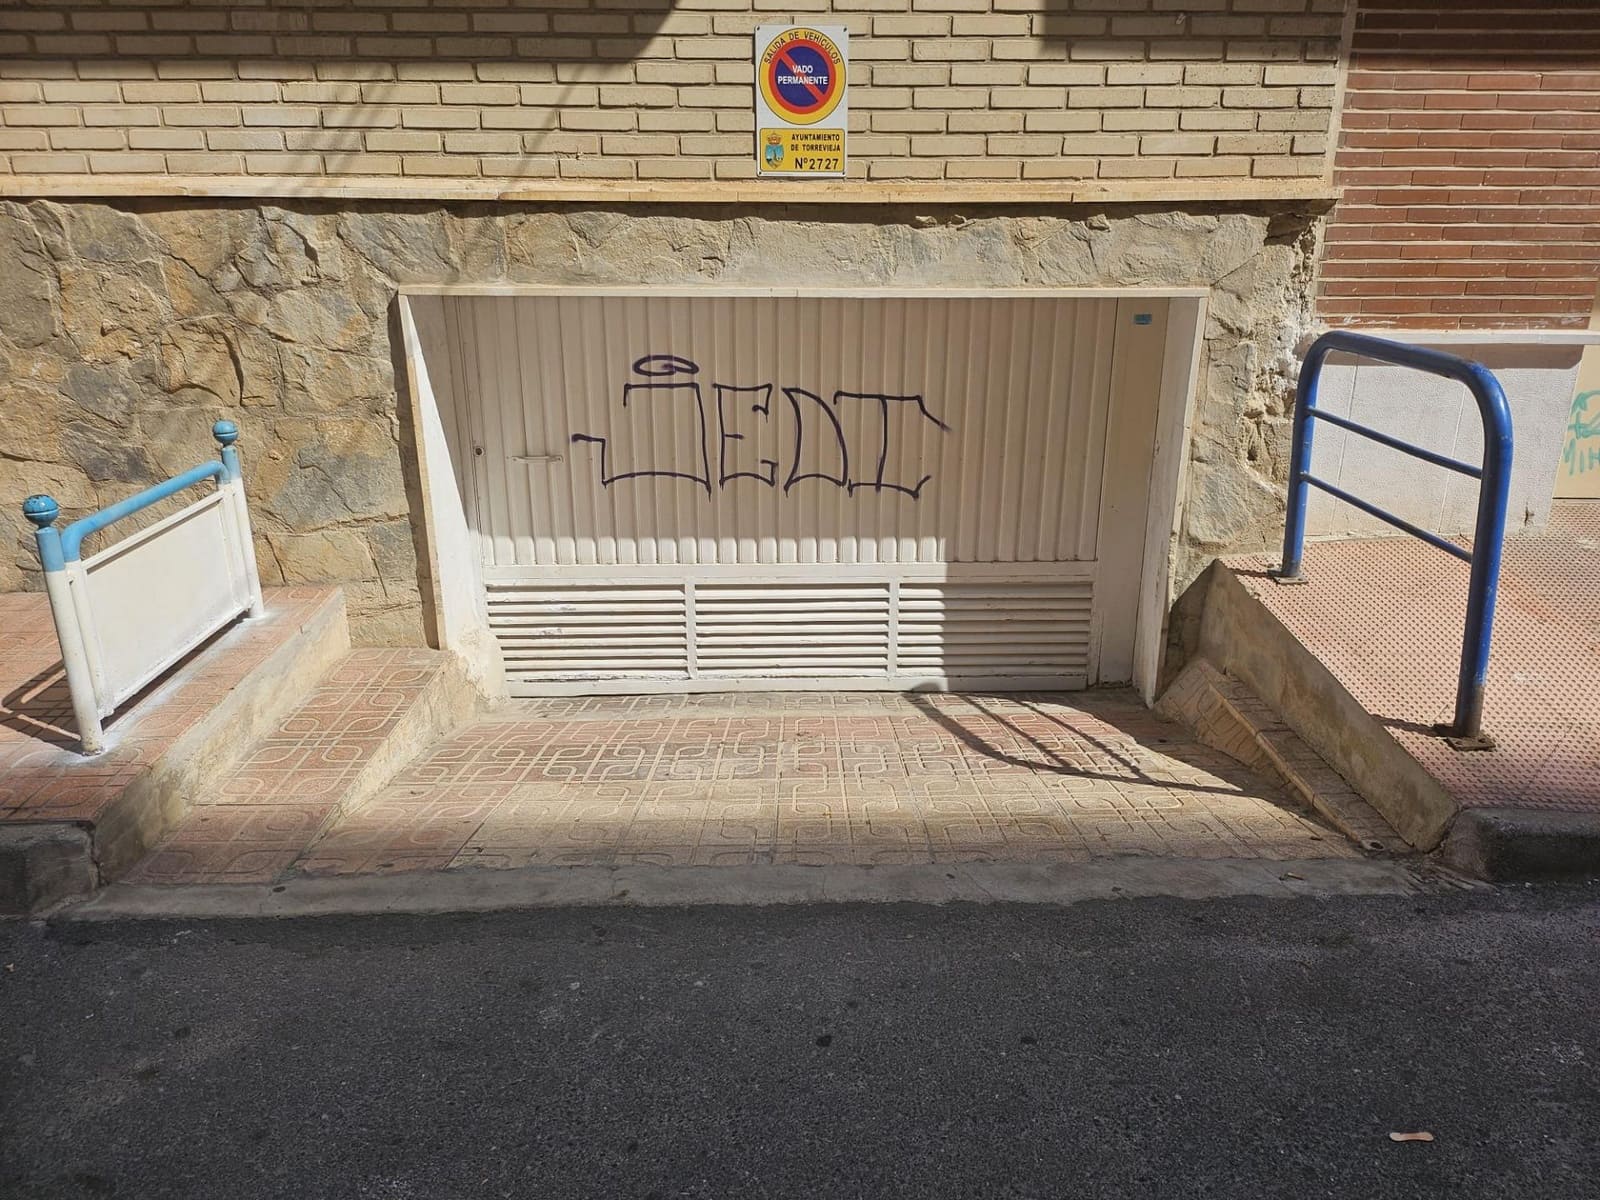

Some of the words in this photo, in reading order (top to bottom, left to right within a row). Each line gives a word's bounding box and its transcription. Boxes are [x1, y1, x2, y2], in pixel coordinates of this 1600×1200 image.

[764, 38, 786, 64] SALIDA
[788, 31, 800, 41] DE
[792, 65, 814, 73] VADO
[777, 76, 829, 85] PERMANENTE
[802, 144, 841, 152] TORREVIEJA
